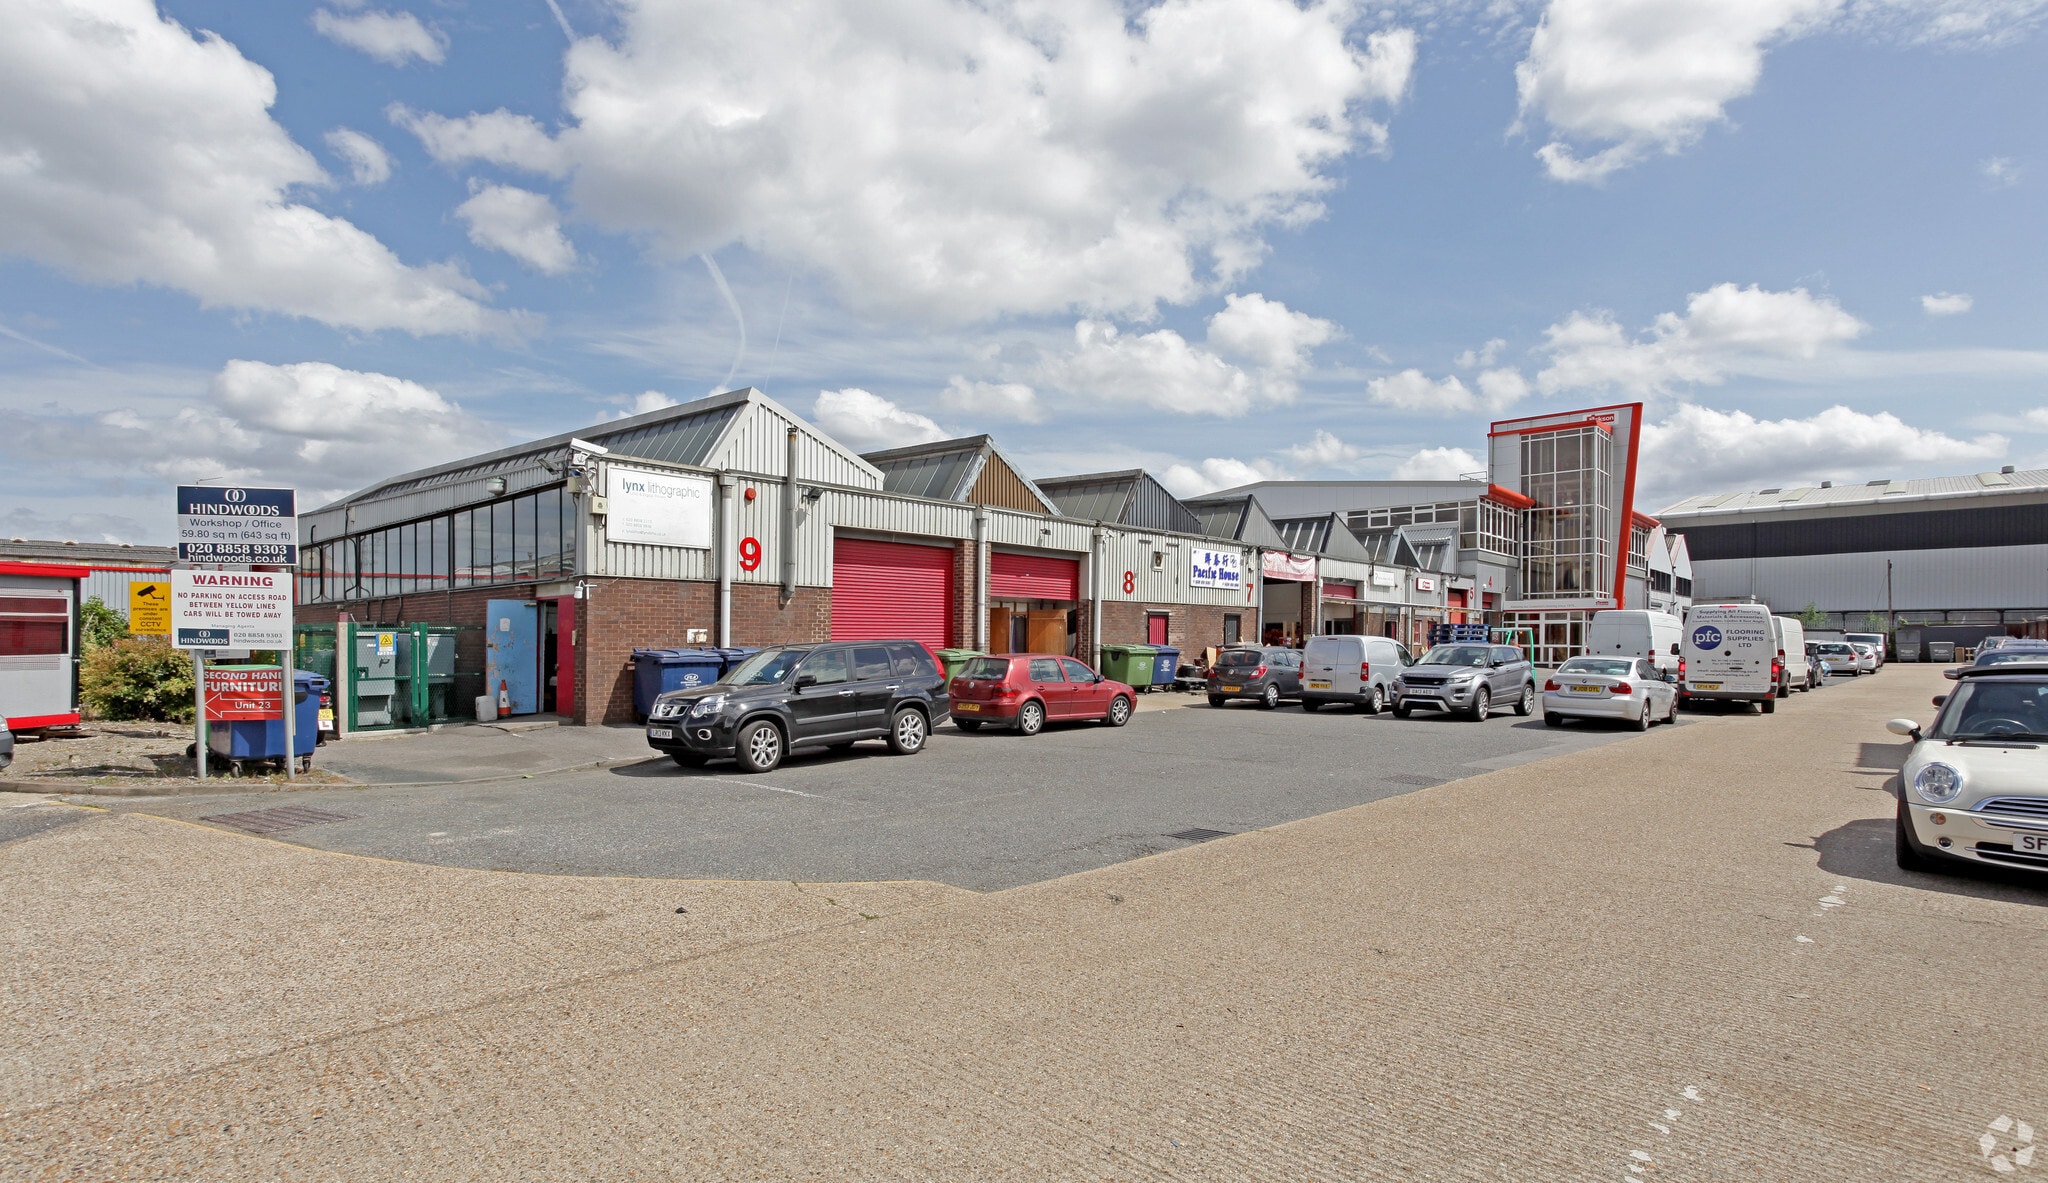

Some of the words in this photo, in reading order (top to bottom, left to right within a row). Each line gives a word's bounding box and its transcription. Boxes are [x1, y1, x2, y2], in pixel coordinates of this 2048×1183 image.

[622, 478, 645, 494] lynx
[648, 481, 700, 498] lithographic
[190, 504, 280, 516] HINDWOODS
[190, 518, 242, 528] Workshop
[244, 520, 249, 528] /
[252, 520, 282, 528] Office
[182, 530, 210, 538] 59.80
[212, 532, 225, 540] sq
[241, 531, 262, 540] (643
[265, 532, 277, 540] sq
[280, 532, 291, 540] ft)
[187, 543, 212, 553] 020
[216, 544, 250, 554] 8858
[253, 545, 287, 554] 9303
[739, 536, 761, 572] 9
[188, 552, 287, 563] hindwoods.co.uk
[1193, 565, 1216, 579] Pacific
[1219, 568, 1239, 581] House
[192, 575, 273, 586] WARNING
[1123, 570, 1134, 594] 8
[1488, 576, 1493, 587] 4
[1246, 584, 1253, 602] 7
[1470, 587, 1474, 600] 5
[1695, 630, 1720, 644] pfc
[204, 671, 248, 679] SECOND
[2023, 836, 2048, 850] SF
